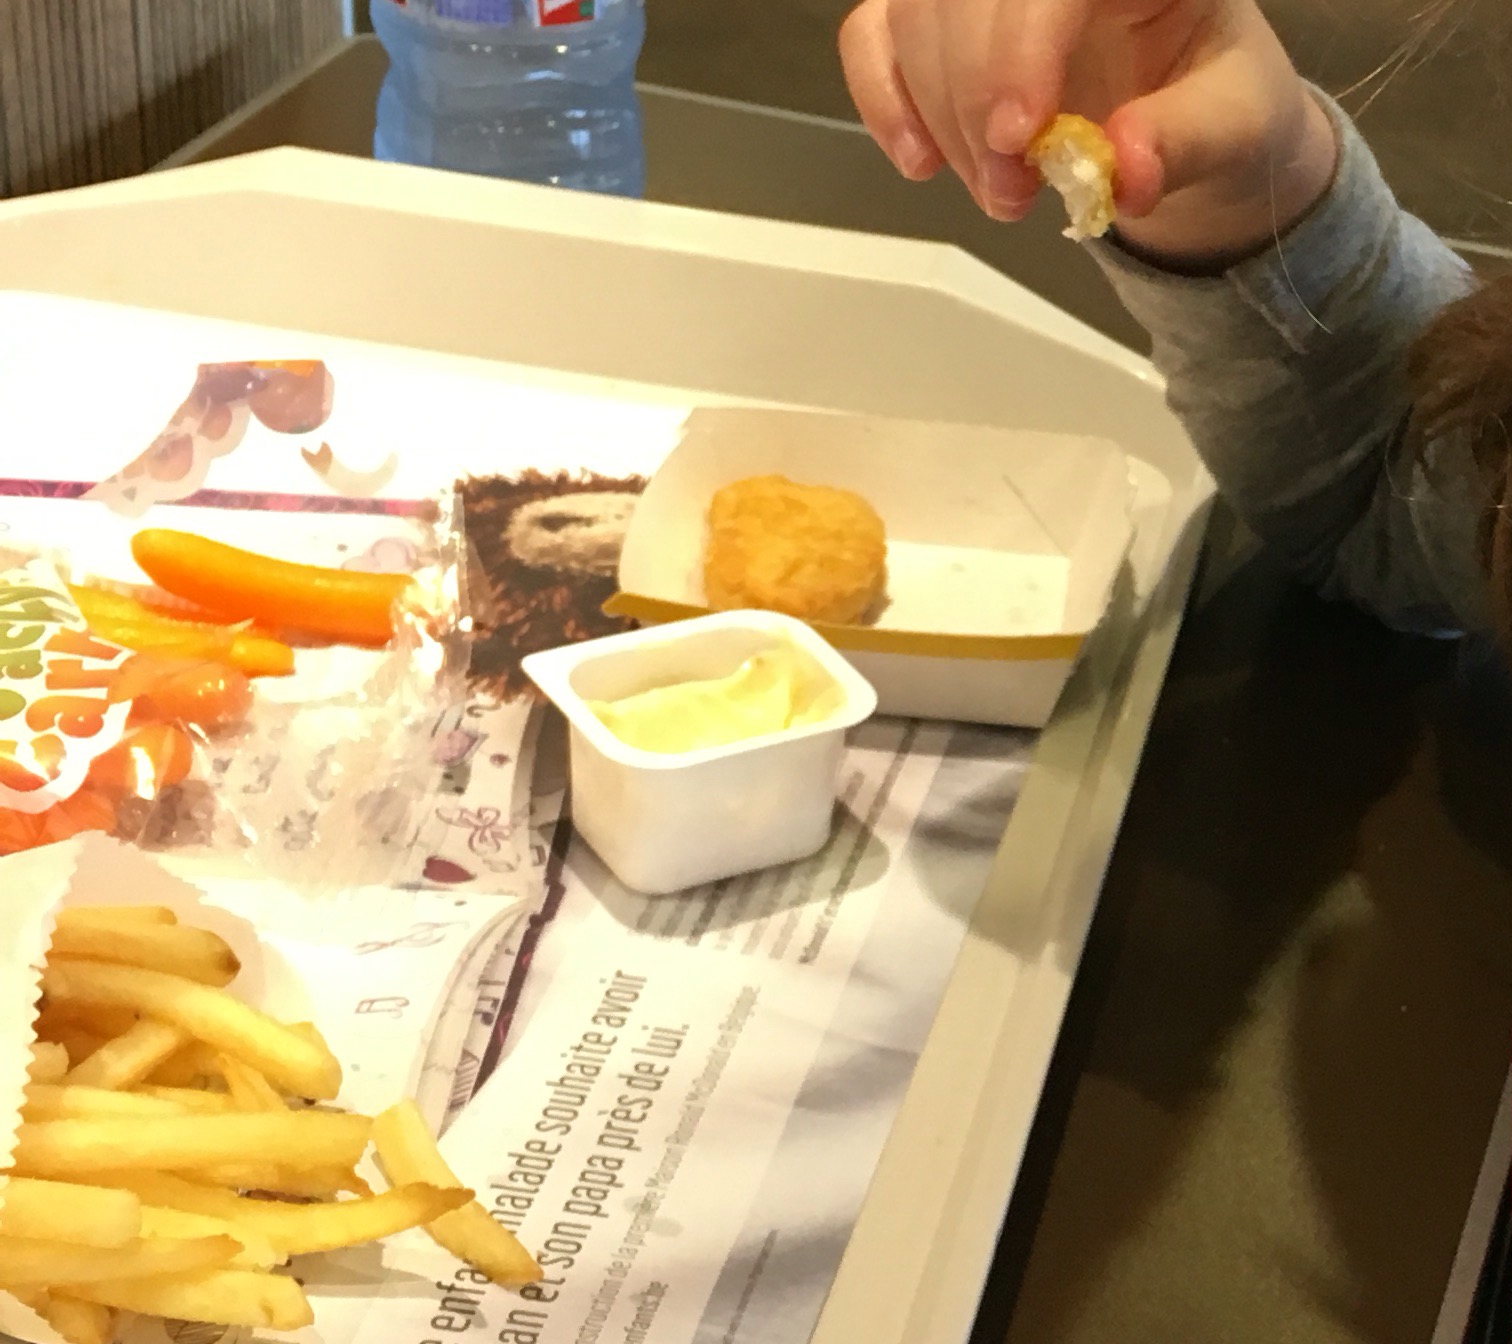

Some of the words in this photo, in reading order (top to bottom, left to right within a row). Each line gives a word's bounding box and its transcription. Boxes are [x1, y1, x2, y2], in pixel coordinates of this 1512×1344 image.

[628, 1023, 690, 1057] lui.
[615, 1061, 669, 1090] de
[430, 1259, 492, 1329] enfa
[533, 1030, 618, 1134] souhaite
[590, 967, 649, 1028] avoir
[595, 1091, 652, 1151] près
[561, 1153, 624, 1218] papa
[533, 1216, 591, 1269] son
